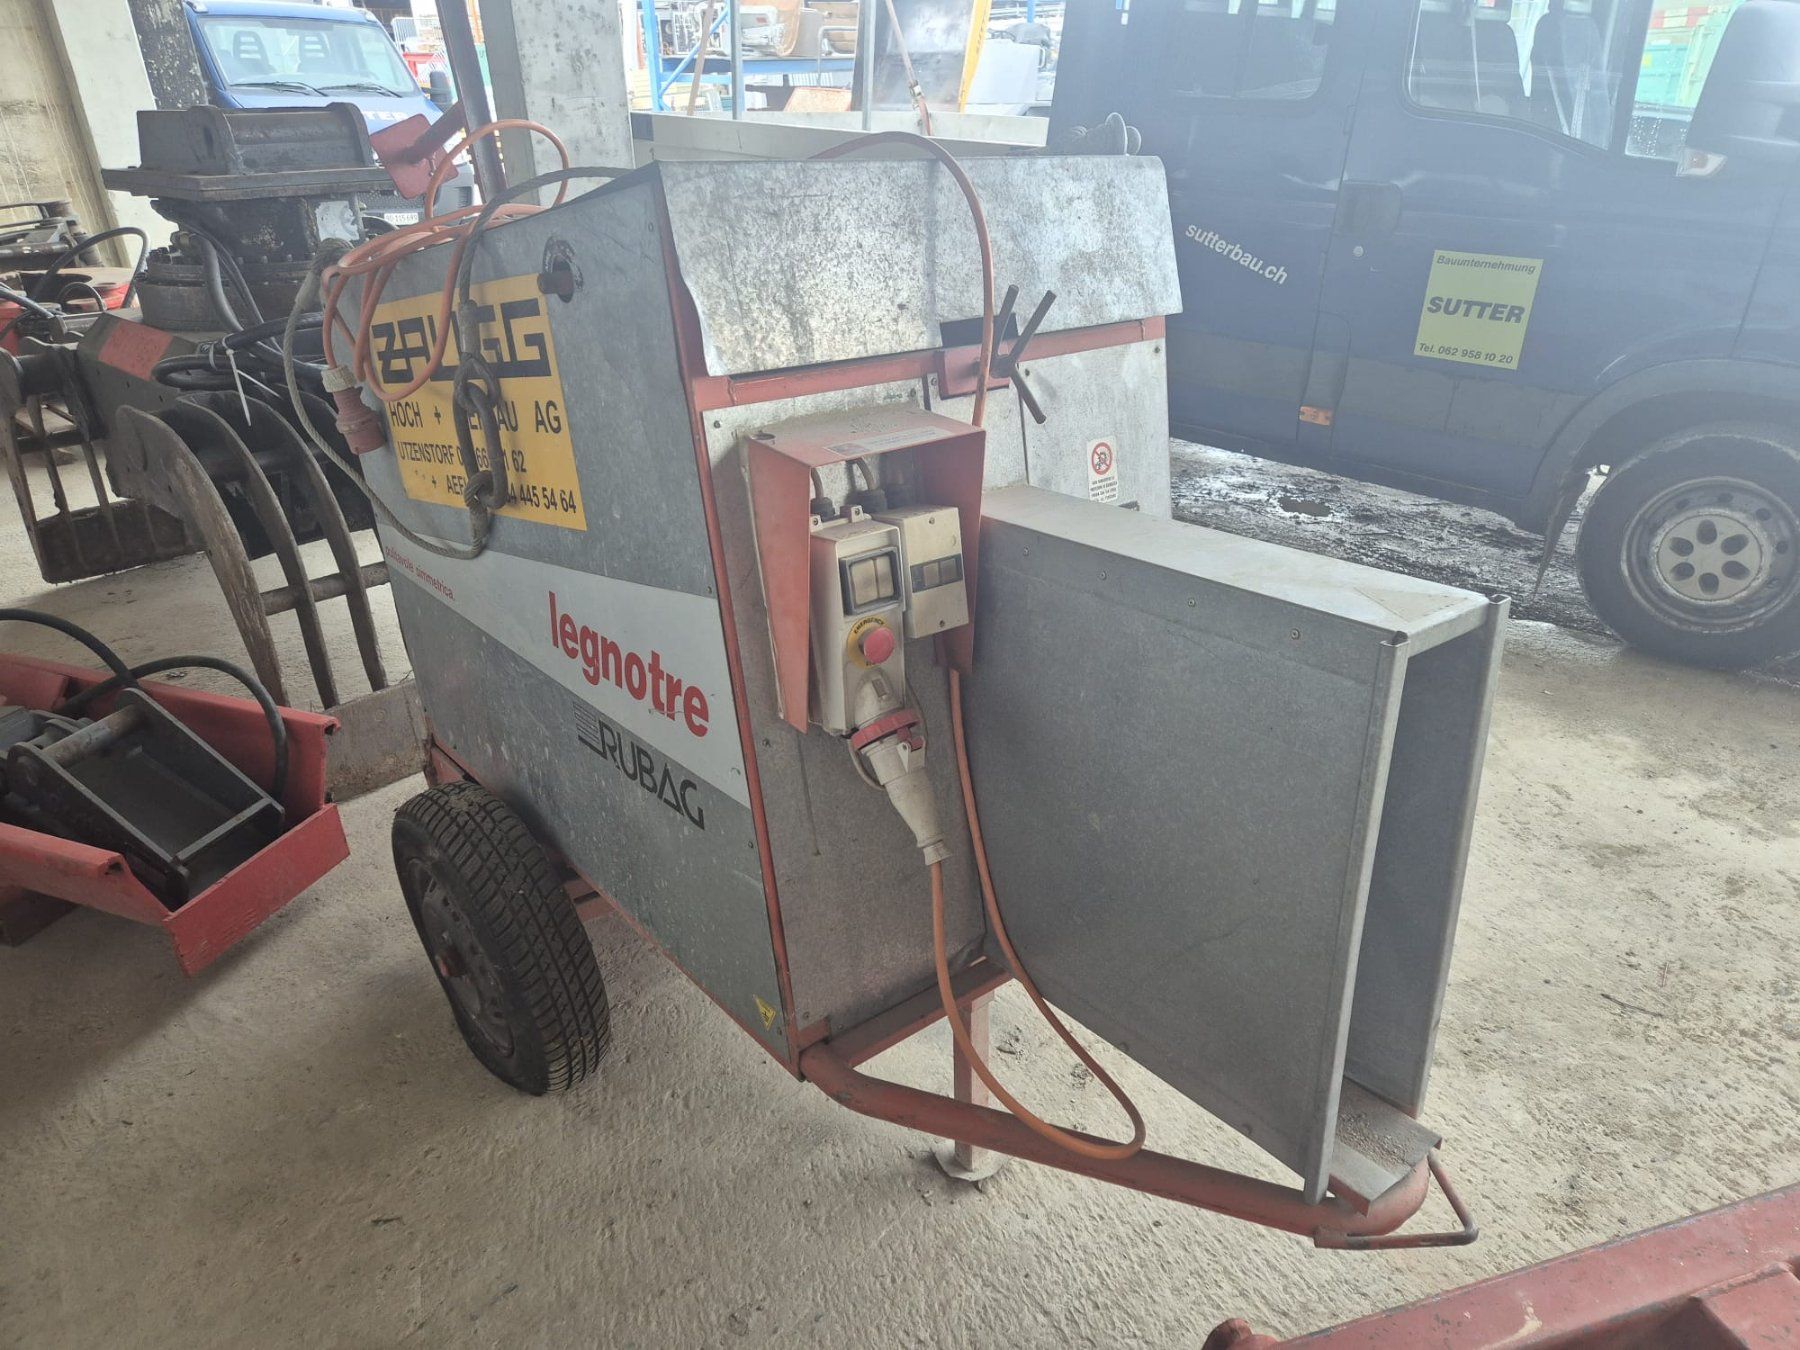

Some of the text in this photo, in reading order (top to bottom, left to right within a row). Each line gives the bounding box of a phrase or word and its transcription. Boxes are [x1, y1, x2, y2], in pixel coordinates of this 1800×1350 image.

[1185, 224, 1288, 285] sutterbau.ch
[1436, 255, 1536, 275] Bauunternehmung
[1426, 296, 1526, 324] SUTTER
[1419, 342, 1434, 353] Tel.
[1438, 345, 1458, 356] 062
[1484, 352, 1496, 362] 10
[1498, 354, 1514, 364] 20
[388, 401, 424, 428] HOCH
[534, 400, 562, 434] AG
[397, 440, 454, 466] UTZENSTORF
[512, 448, 527, 472] 62
[519, 484, 540, 508] 445
[542, 486, 558, 510] 54
[560, 489, 577, 514] 64
[548, 590, 710, 738] legnotre
[597, 719, 705, 830] RUBAG
